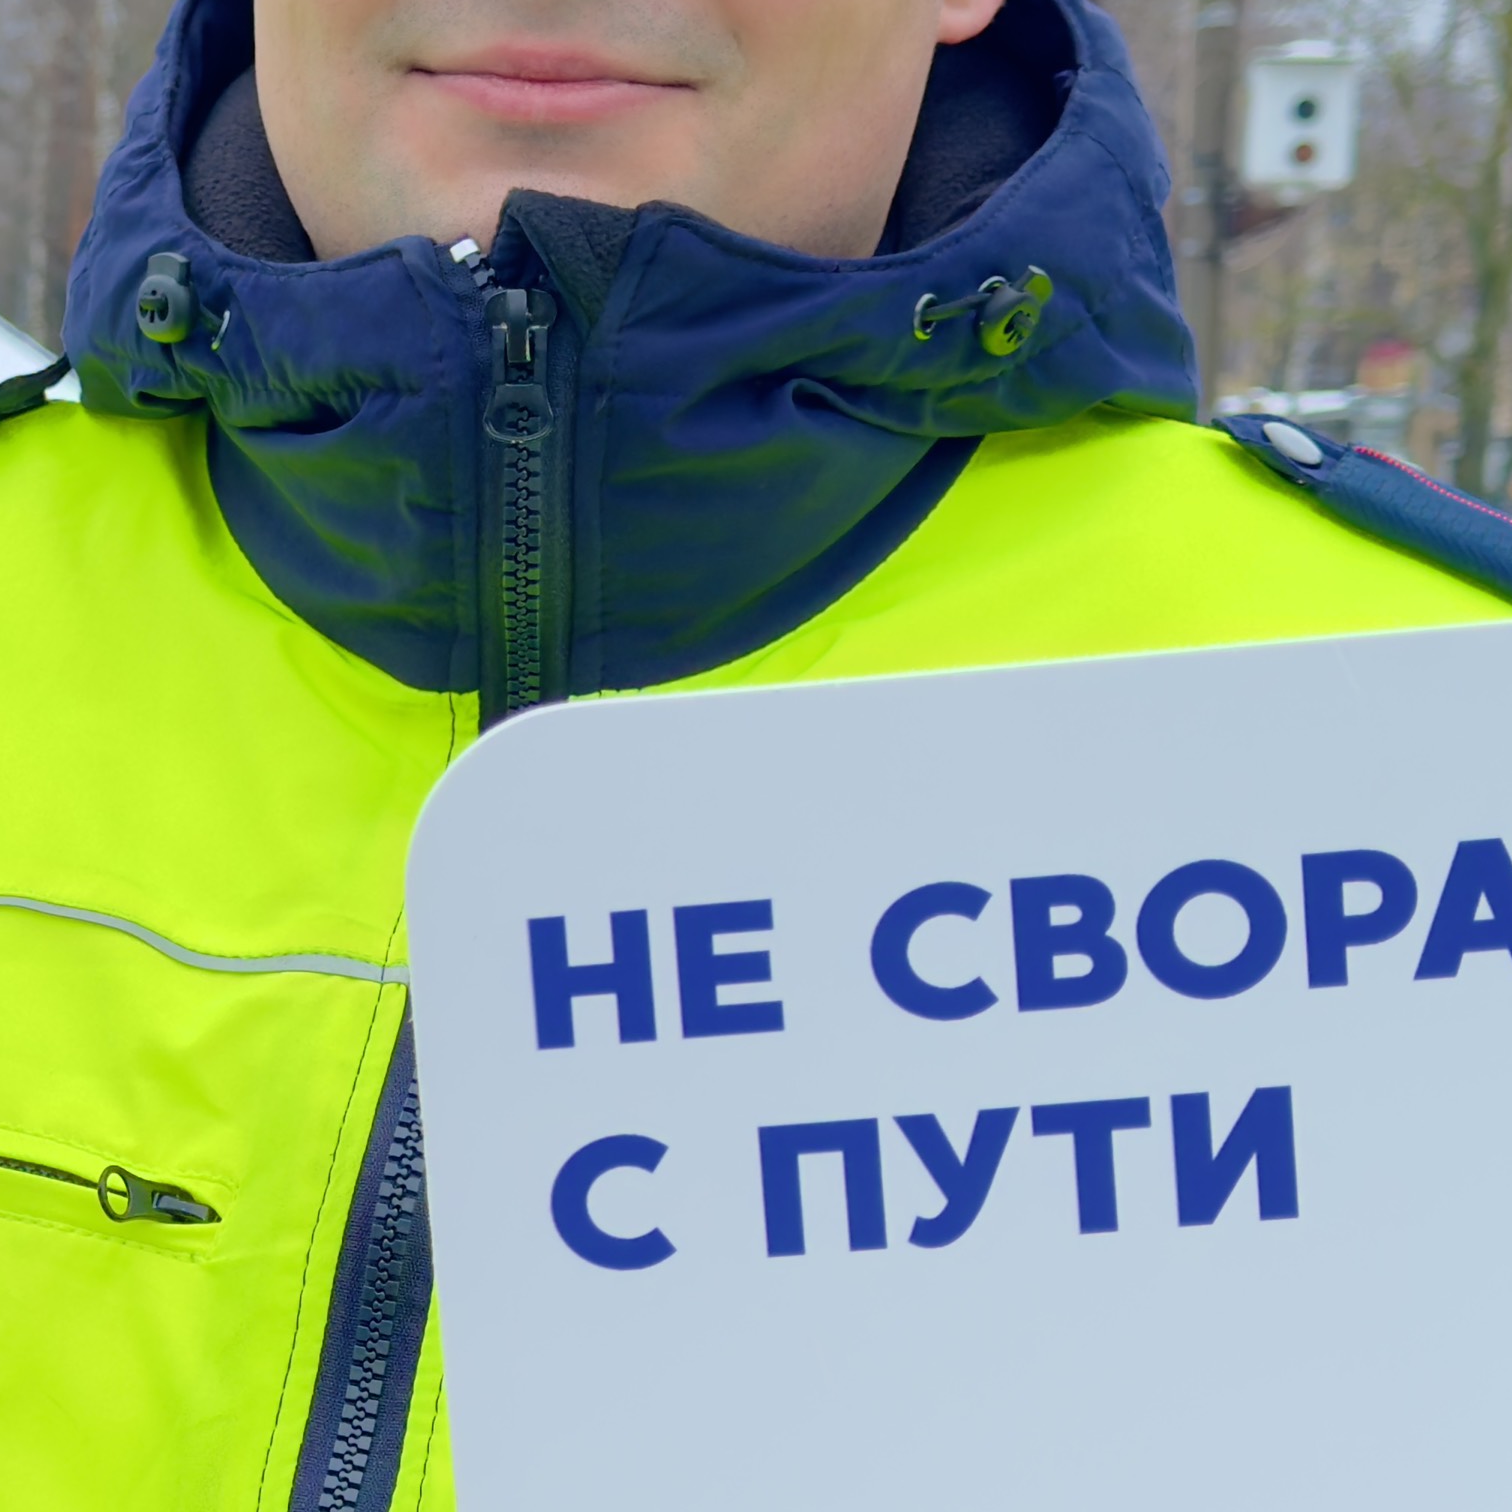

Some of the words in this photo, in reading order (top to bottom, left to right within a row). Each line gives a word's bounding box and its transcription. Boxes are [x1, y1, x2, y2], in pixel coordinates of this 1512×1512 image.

[528, 899, 784, 1049] НЕ
[551, 1134, 676, 1270] С
[759, 1086, 1298, 1257] ПУТИ
